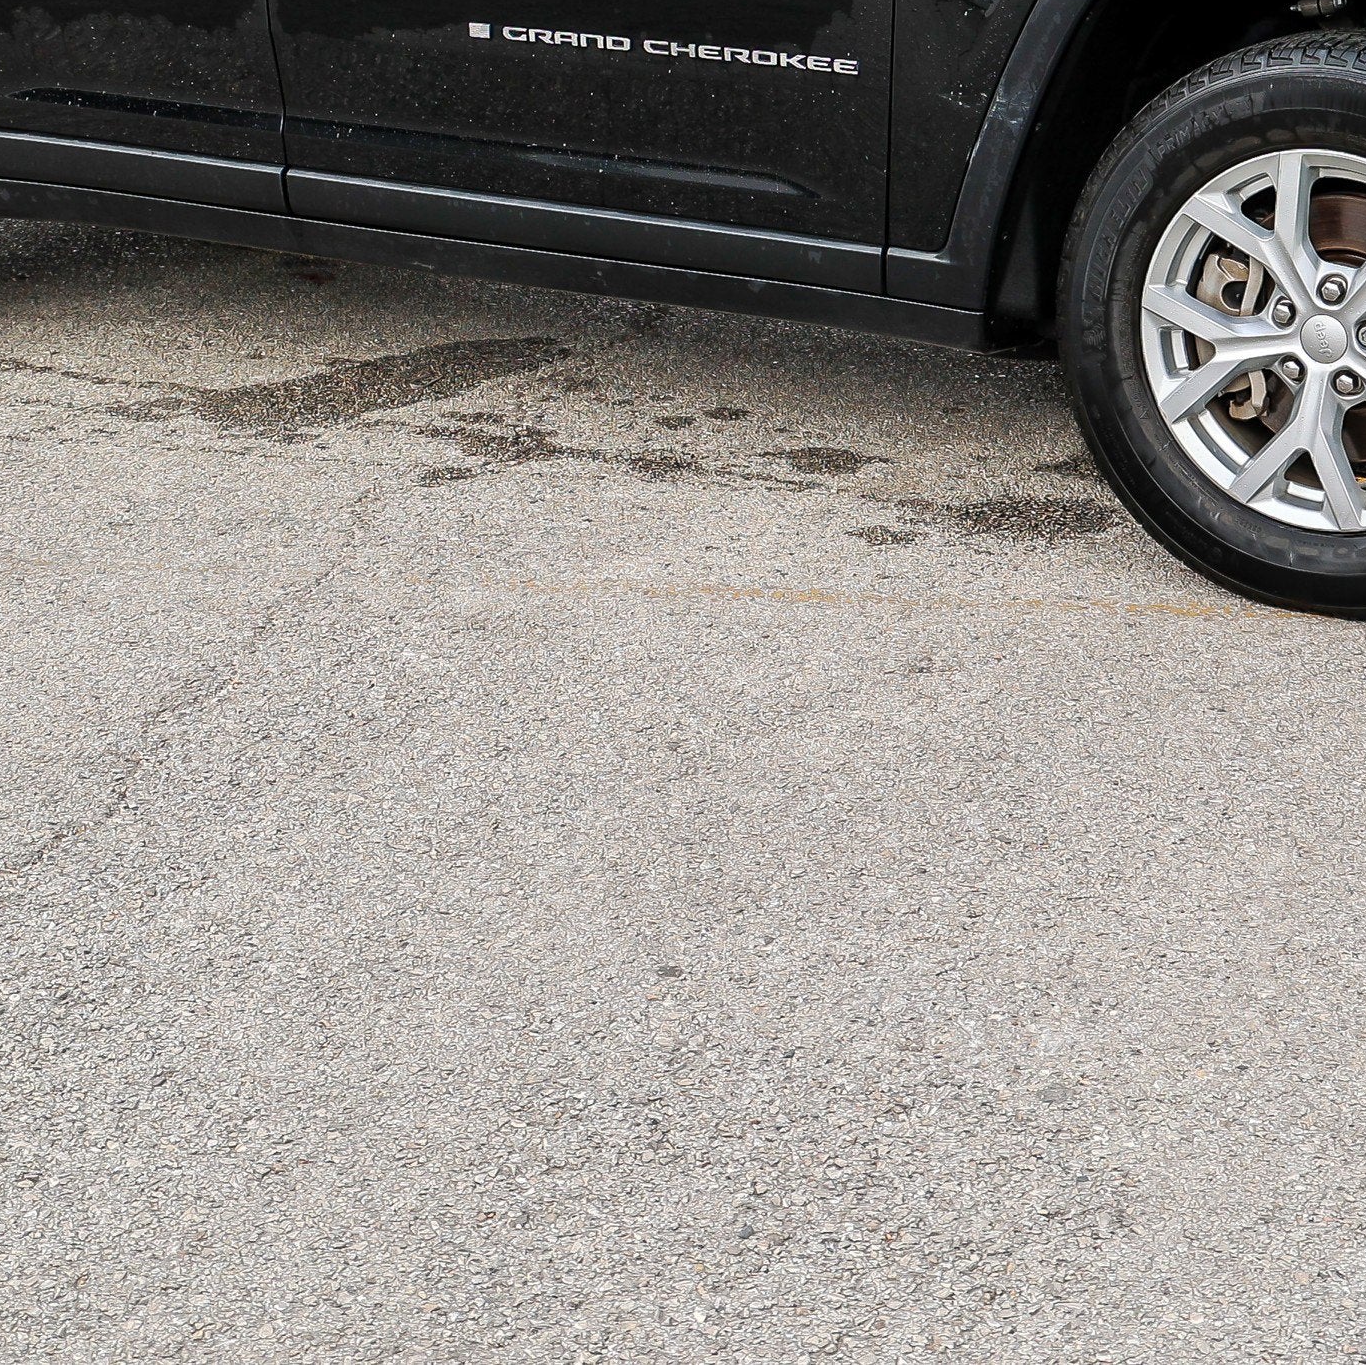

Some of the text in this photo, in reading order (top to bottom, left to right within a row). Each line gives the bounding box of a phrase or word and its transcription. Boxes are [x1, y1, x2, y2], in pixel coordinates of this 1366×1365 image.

[502, 26, 859, 75] GRAND CHEROKEE
[1315, 321, 1333, 358] Jeep
